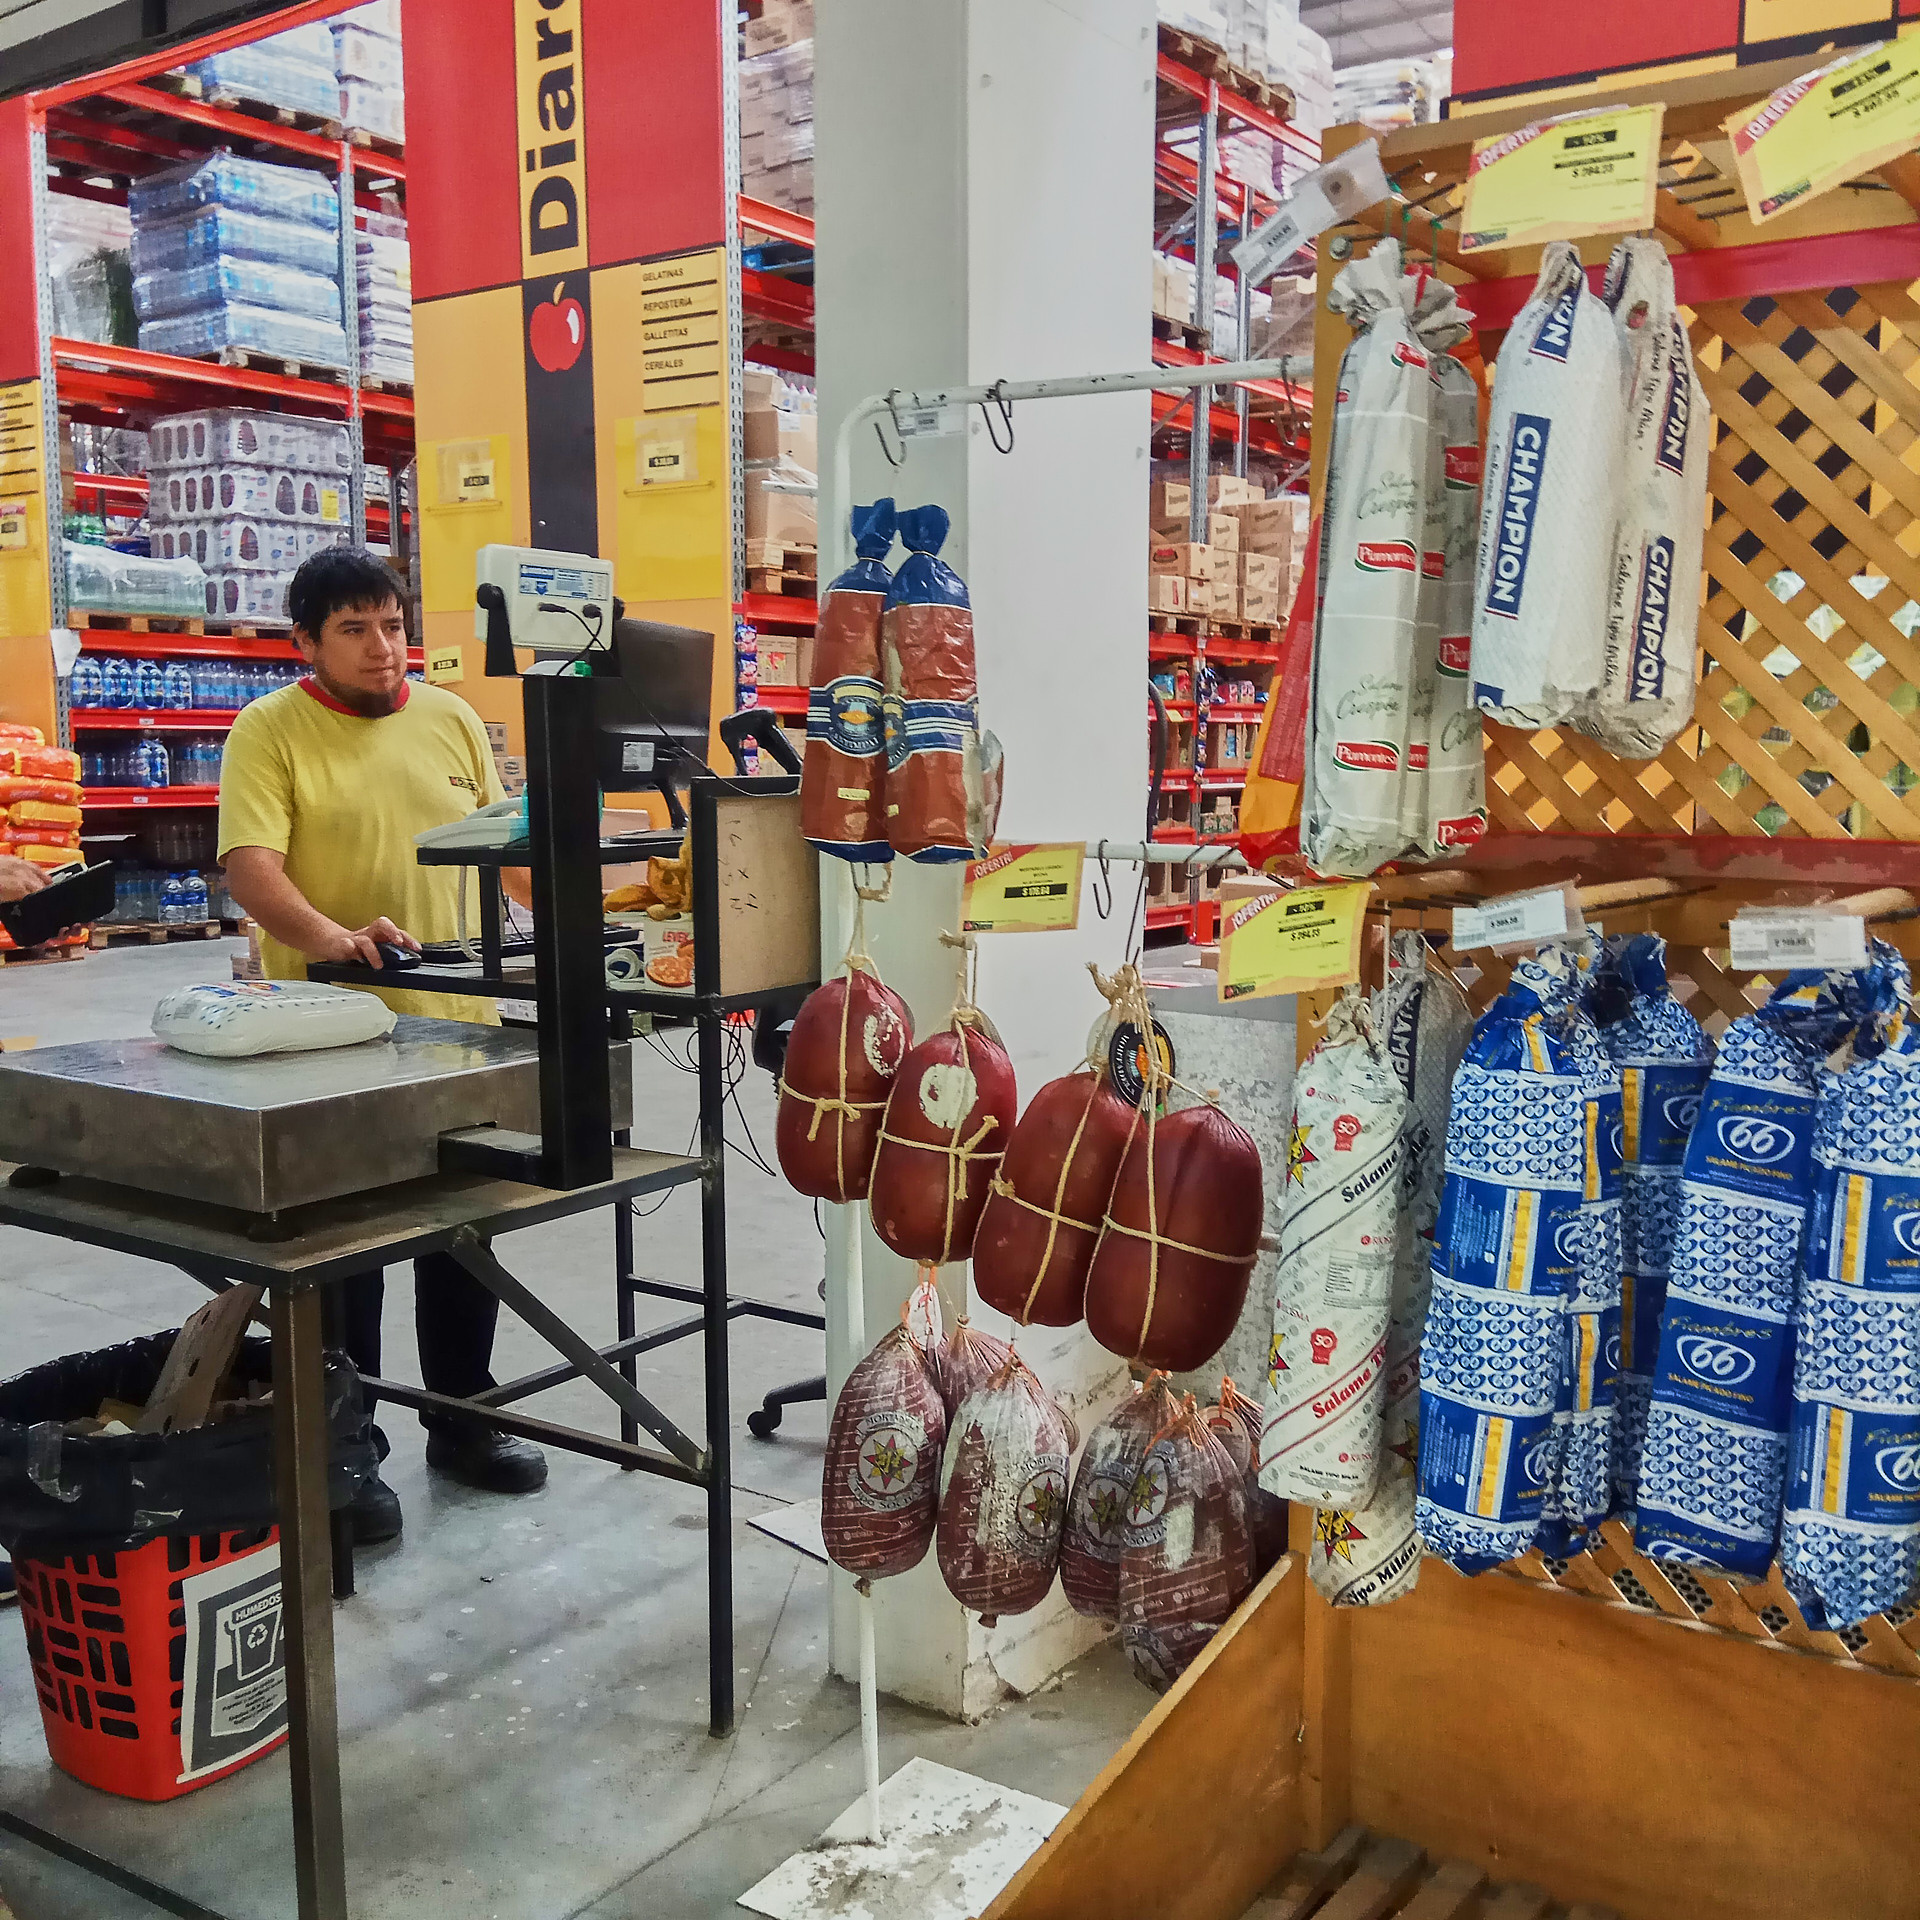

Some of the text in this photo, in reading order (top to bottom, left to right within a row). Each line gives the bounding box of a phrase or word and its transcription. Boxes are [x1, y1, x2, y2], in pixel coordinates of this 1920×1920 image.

[526, 0, 579, 256] Diar
[642, 267, 684, 282] GELATINAS
[643, 296, 693, 312] REPOSTERÍA
[643, 327, 688, 341] GALLETITAS
[644, 358, 684, 371] CEREALES
[1493, 425, 1542, 603] CHAMPION
[1634, 545, 1670, 700] CHAMPION
[1730, 1119, 1776, 1154] 66
[1691, 1343, 1738, 1375] 66
[1311, 1366, 1373, 1420] Salame
[235, 1592, 281, 1621] HUMEDOS
